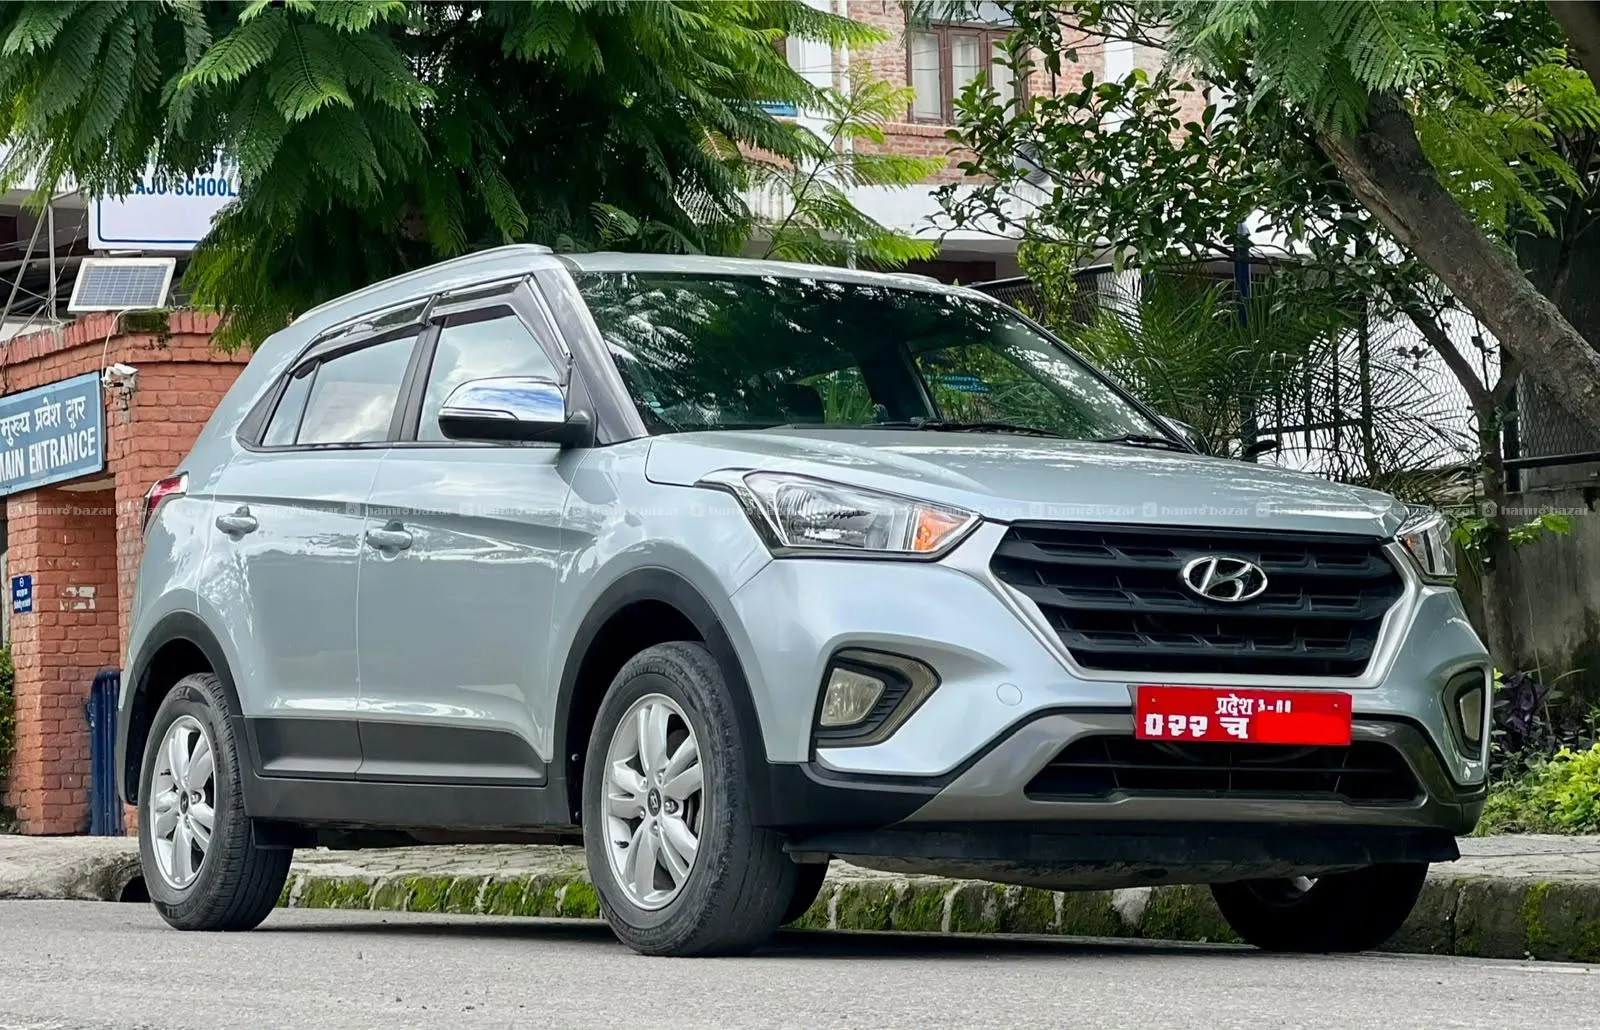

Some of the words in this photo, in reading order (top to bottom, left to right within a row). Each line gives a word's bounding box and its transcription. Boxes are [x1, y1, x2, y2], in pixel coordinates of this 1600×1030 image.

[175, 177, 237, 197] SCHOOL
[34, 396, 61, 432] प्रवेश
[29, 427, 96, 474] ENTRANCE
[1215, 693, 1254, 716] प्रदेश
